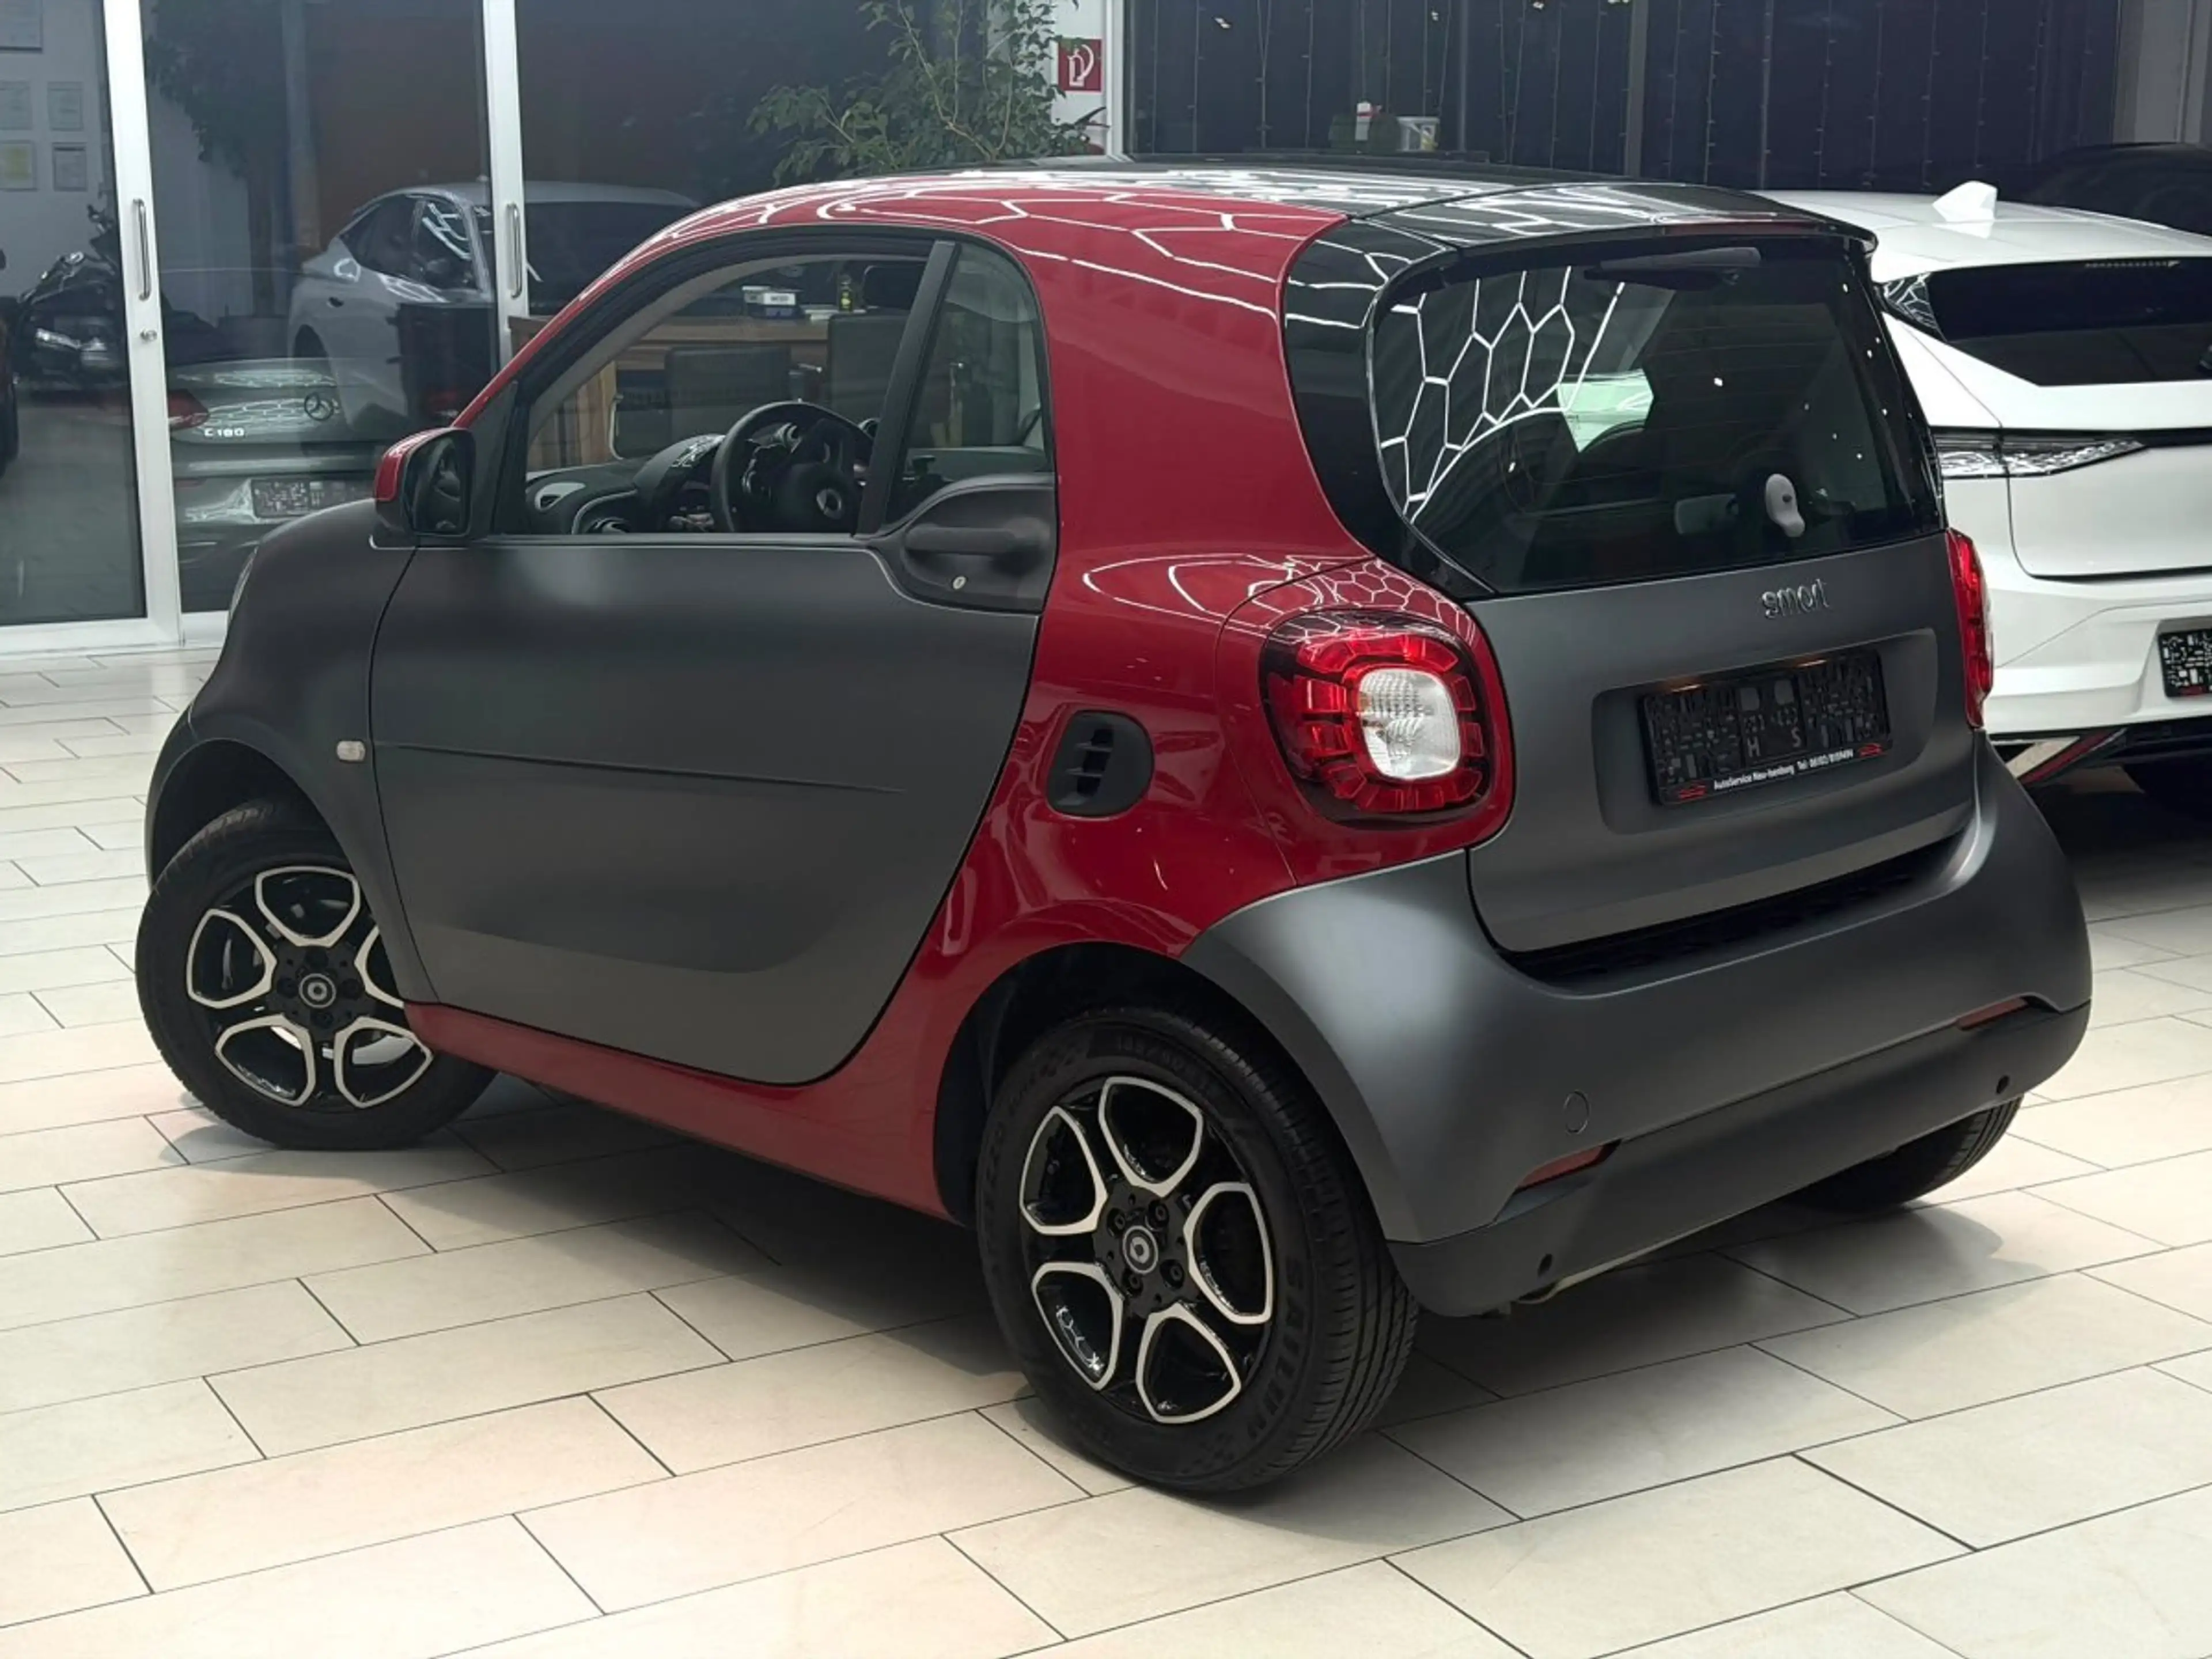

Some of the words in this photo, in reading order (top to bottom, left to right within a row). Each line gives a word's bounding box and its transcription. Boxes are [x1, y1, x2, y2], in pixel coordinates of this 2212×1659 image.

[204, 427, 214, 437] C
[1760, 578, 1831, 620] smart
[1247, 1255, 1305, 1440] SAILUN
